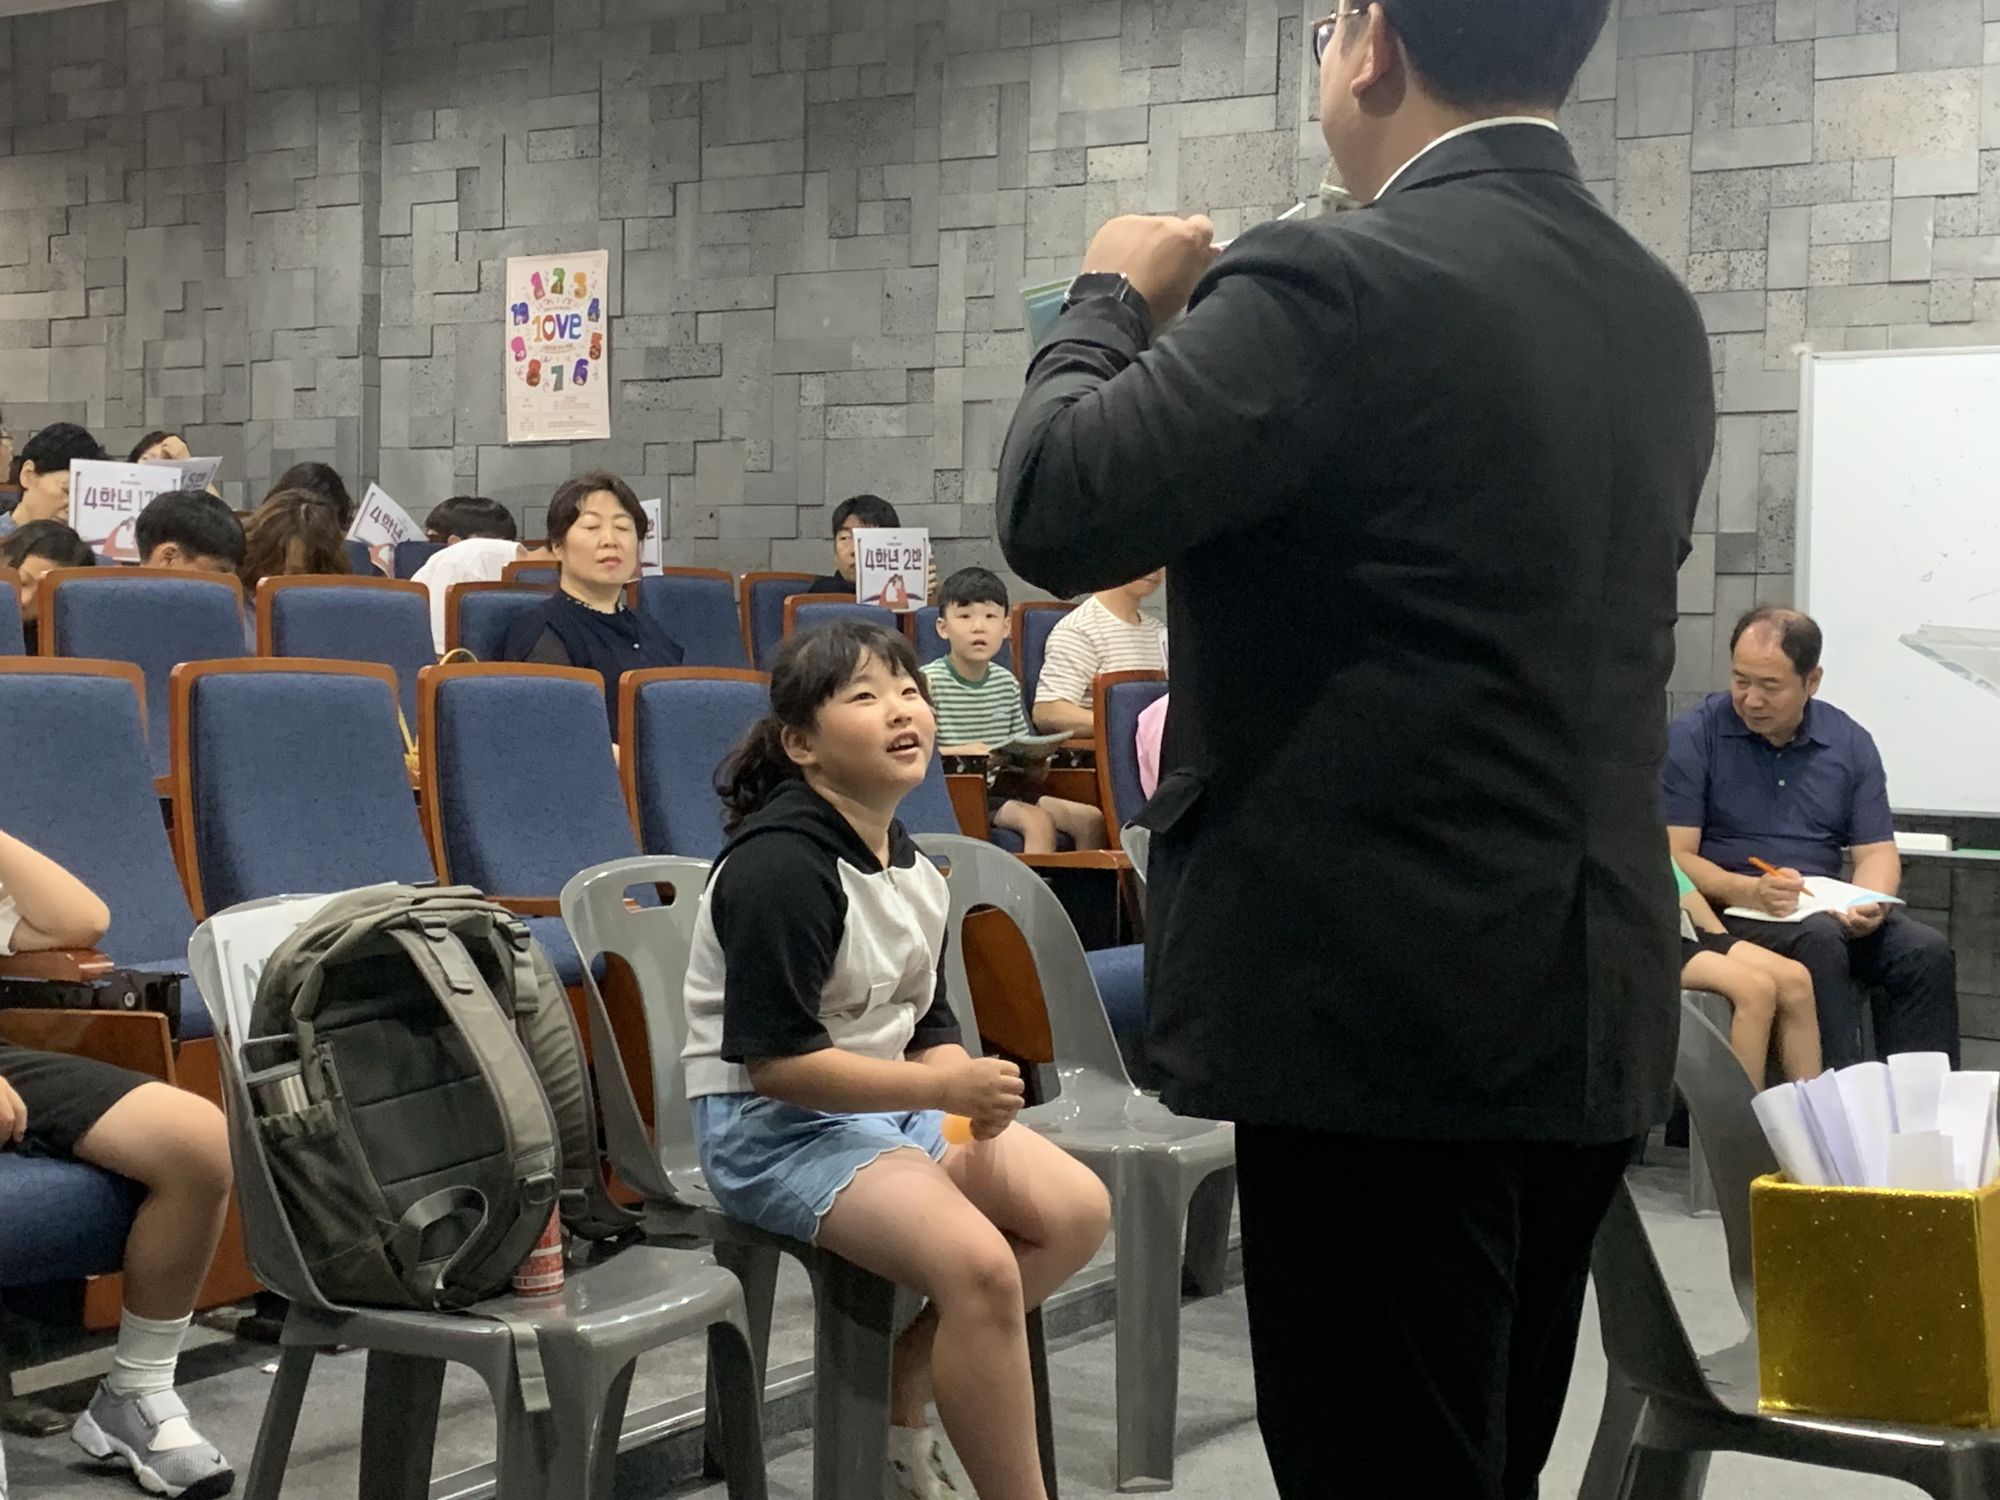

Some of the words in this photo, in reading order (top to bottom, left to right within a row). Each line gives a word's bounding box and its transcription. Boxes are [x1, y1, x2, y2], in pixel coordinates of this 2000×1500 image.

[550, 267, 565, 295] 2
[573, 271, 587, 299] 3
[587, 298, 600, 323] 4
[511, 336, 527, 362] 9
[526, 358, 542, 387] 8
[551, 365, 564, 392] 7
[573, 358, 589, 386] 6
[83, 486, 133, 512] 4학년
[864, 548, 899, 571] 4학년
[903, 548, 922, 571] 2반
